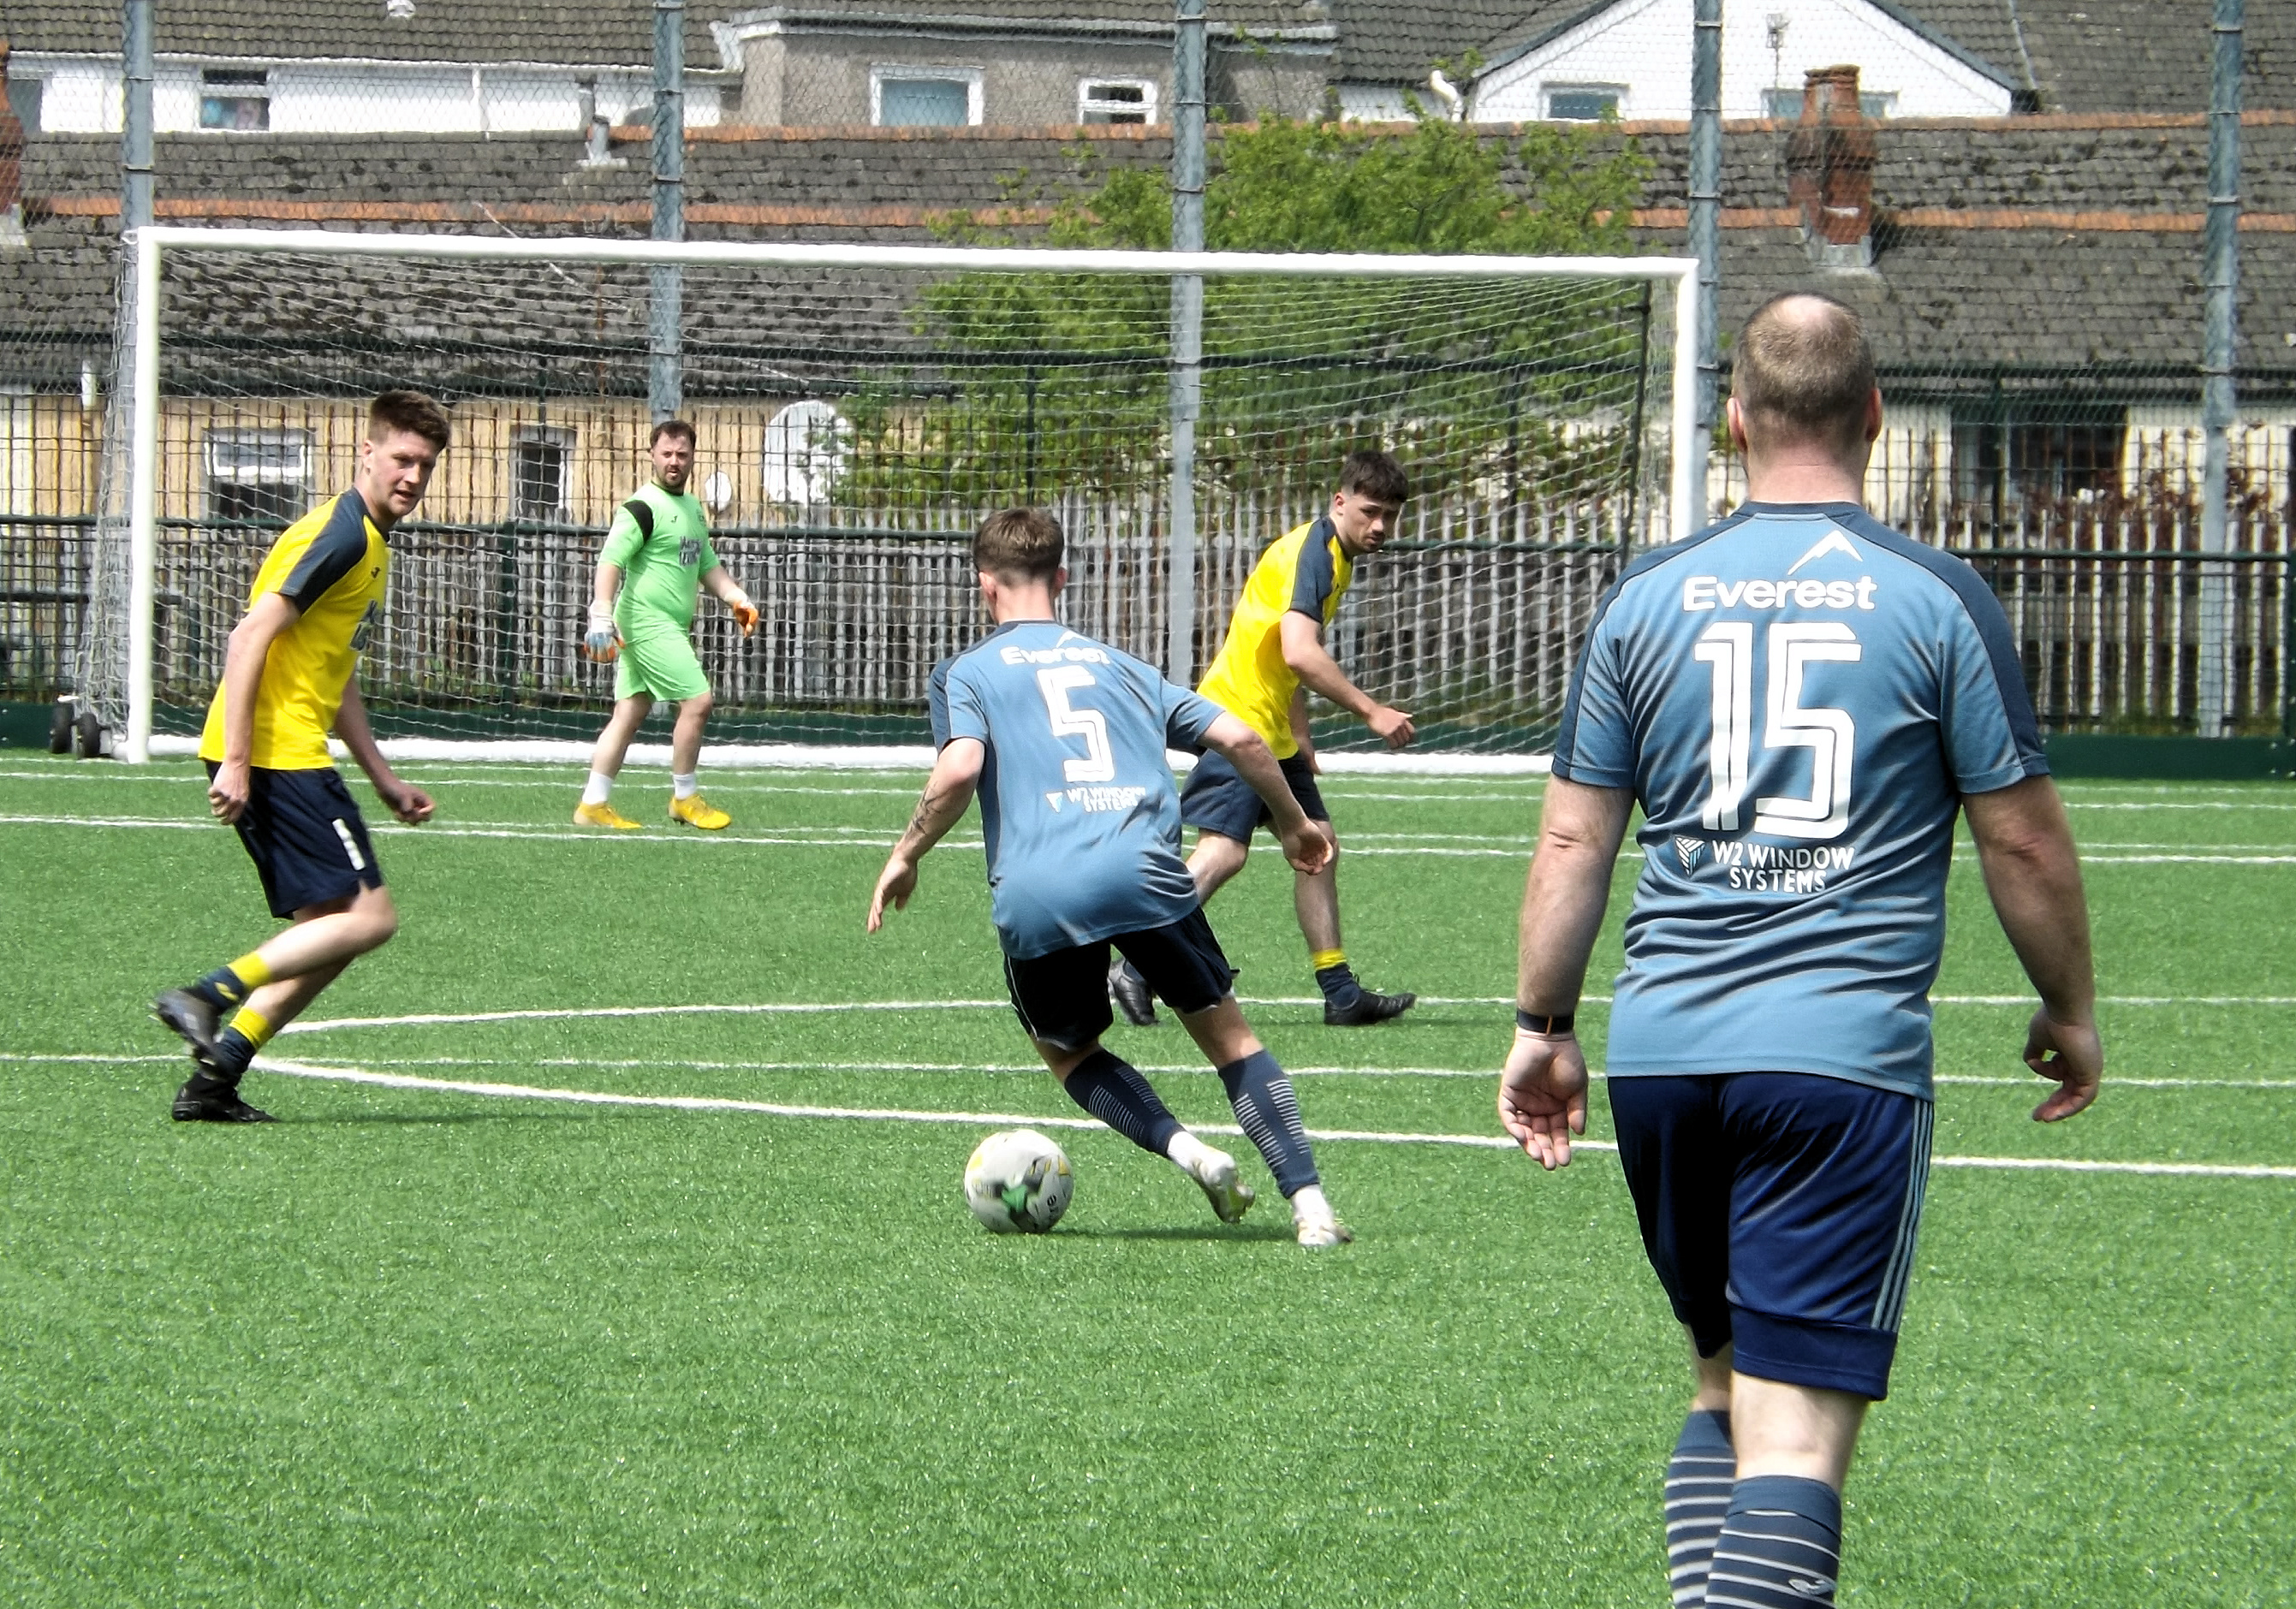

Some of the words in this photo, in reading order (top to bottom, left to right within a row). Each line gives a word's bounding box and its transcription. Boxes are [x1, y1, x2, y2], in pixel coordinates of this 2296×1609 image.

[1683, 575, 1878, 611] Everest
[1000, 646, 1110, 665] Everest
[1037, 665, 1115, 782] 5
[1694, 621, 1862, 839] 15
[1713, 840, 1744, 866] W2
[1747, 843, 1854, 870] WINDOW
[1729, 866, 1827, 894] SYSTEMS
